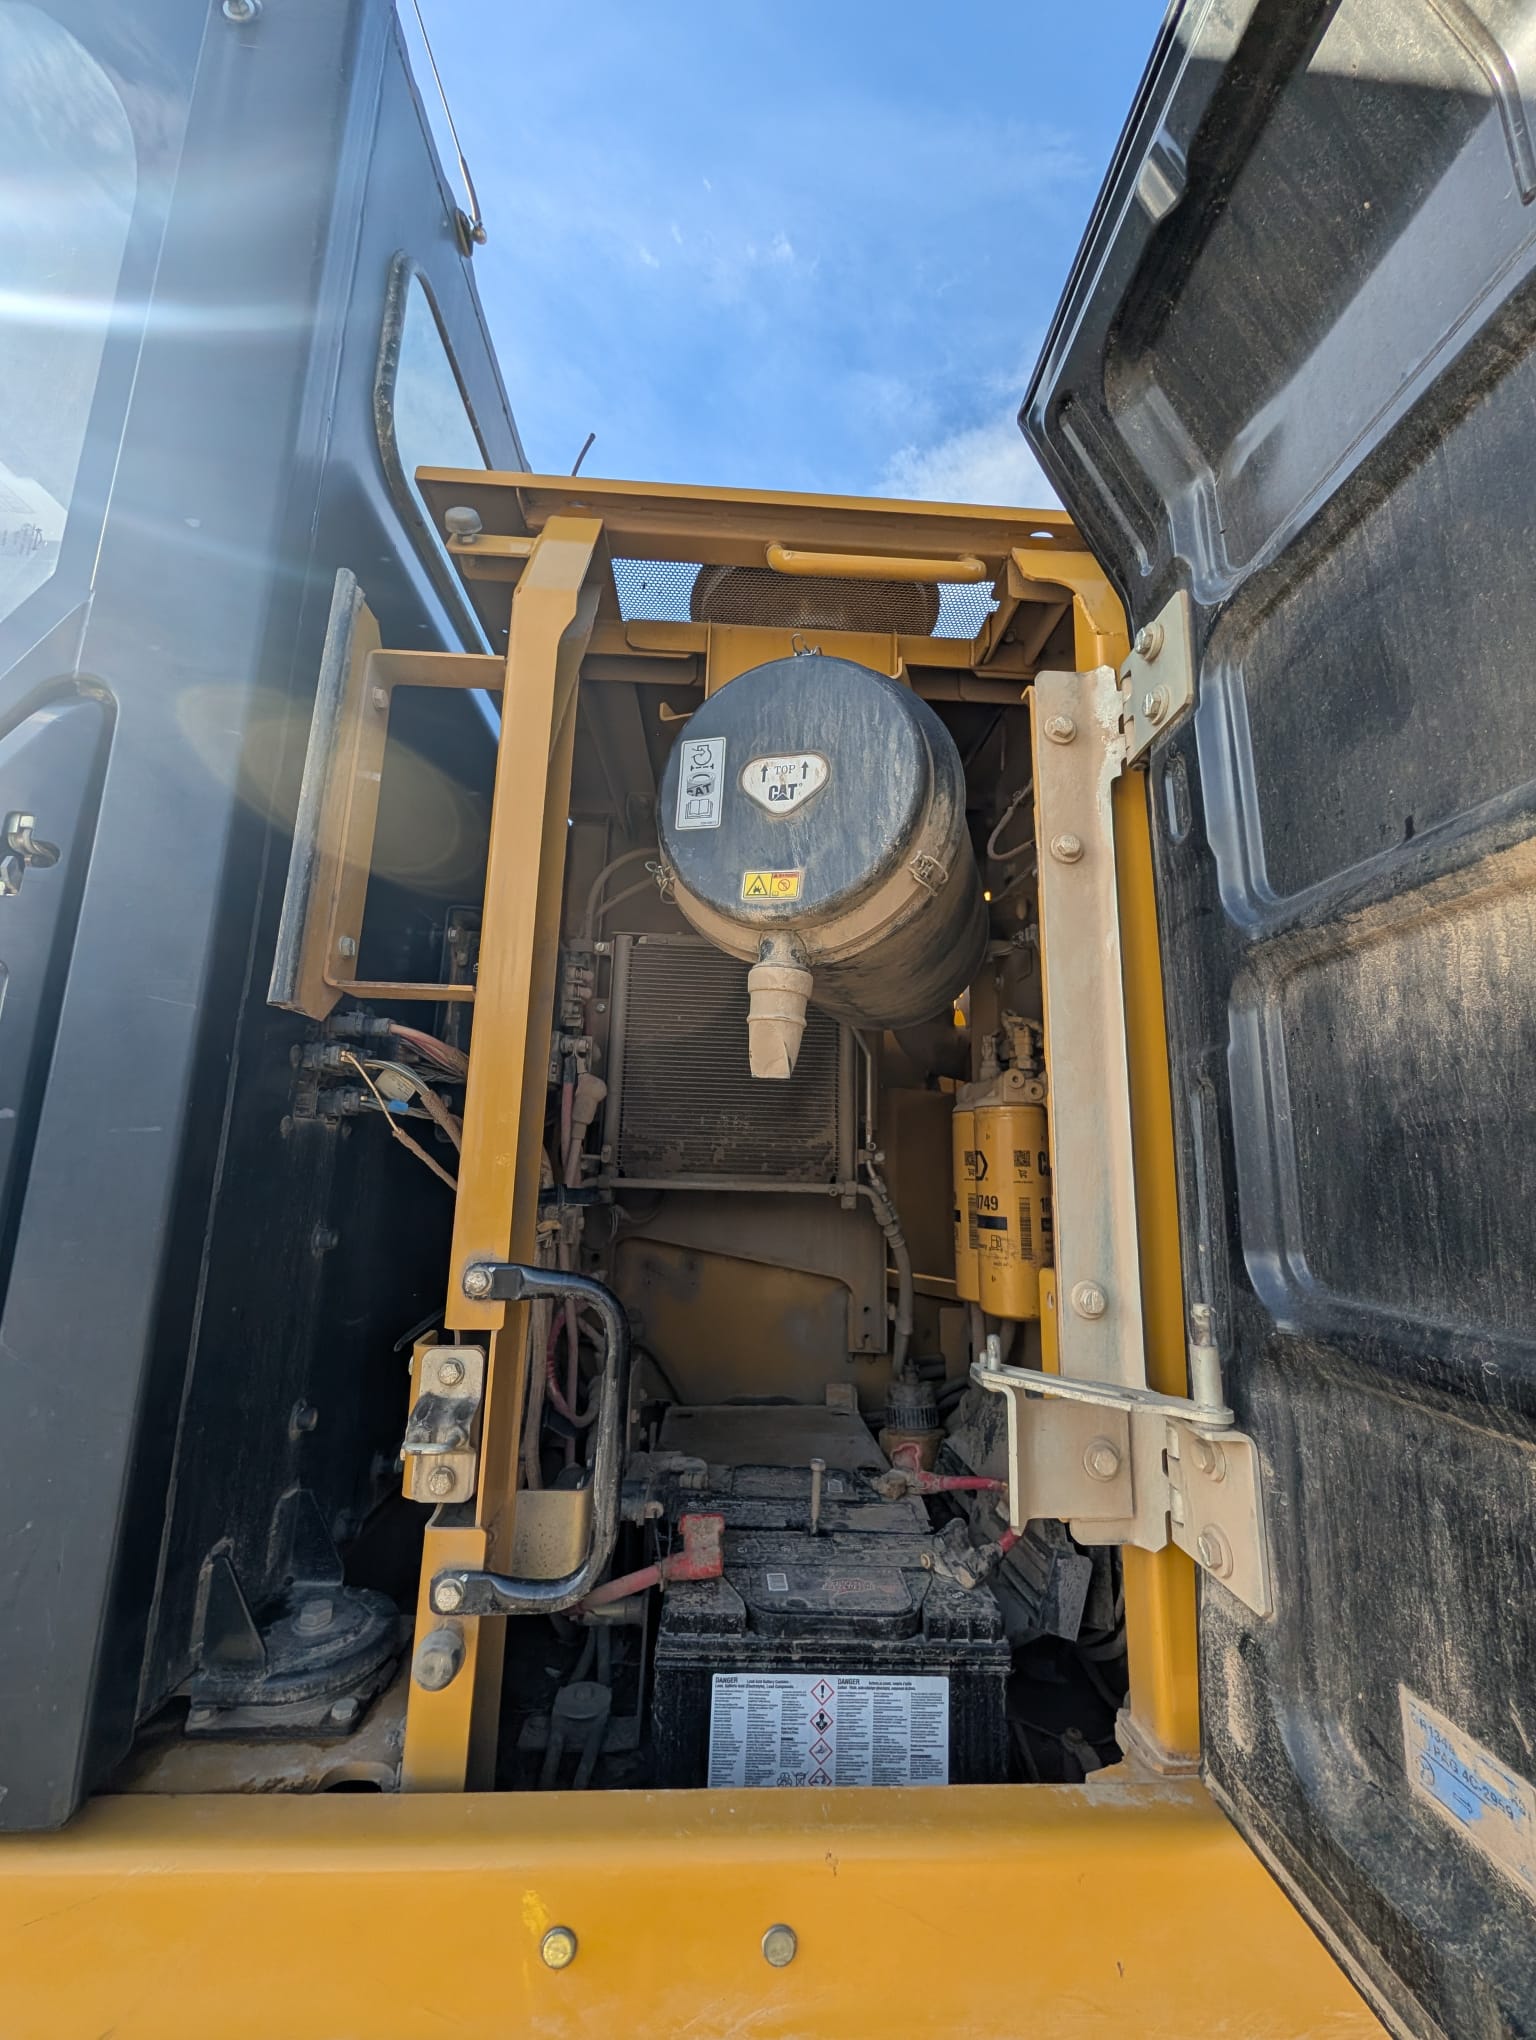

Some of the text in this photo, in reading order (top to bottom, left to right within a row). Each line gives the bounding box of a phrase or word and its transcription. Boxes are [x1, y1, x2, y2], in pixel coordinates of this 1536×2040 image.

[774, 764, 796, 775] TOP
[768, 783, 798, 801] CAT
[715, 1676, 738, 1684] DANGER
